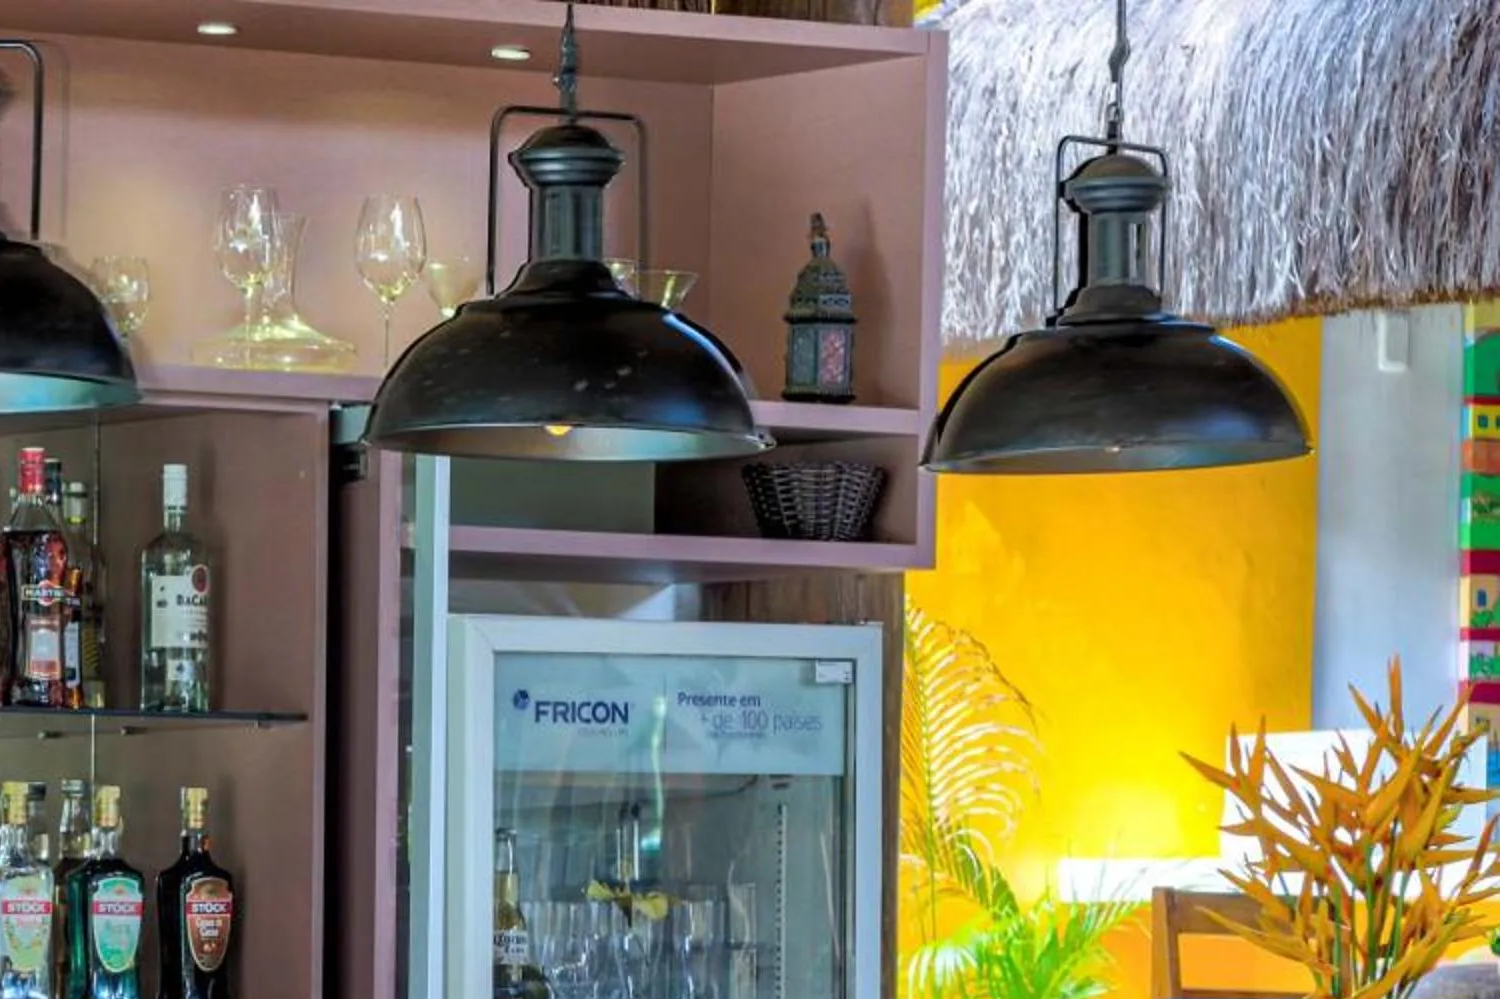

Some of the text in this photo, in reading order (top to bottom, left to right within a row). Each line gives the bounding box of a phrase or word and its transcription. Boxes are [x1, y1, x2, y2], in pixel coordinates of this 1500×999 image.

[677, 691, 761, 708] Presente em
[534, 701, 630, 725] FRICON
[712, 711, 734, 731] de
[742, 709, 768, 731] 100
[7, 901, 46, 913] STOCK
[99, 902, 136, 913] STOCK
[191, 902, 228, 913] STOCK
